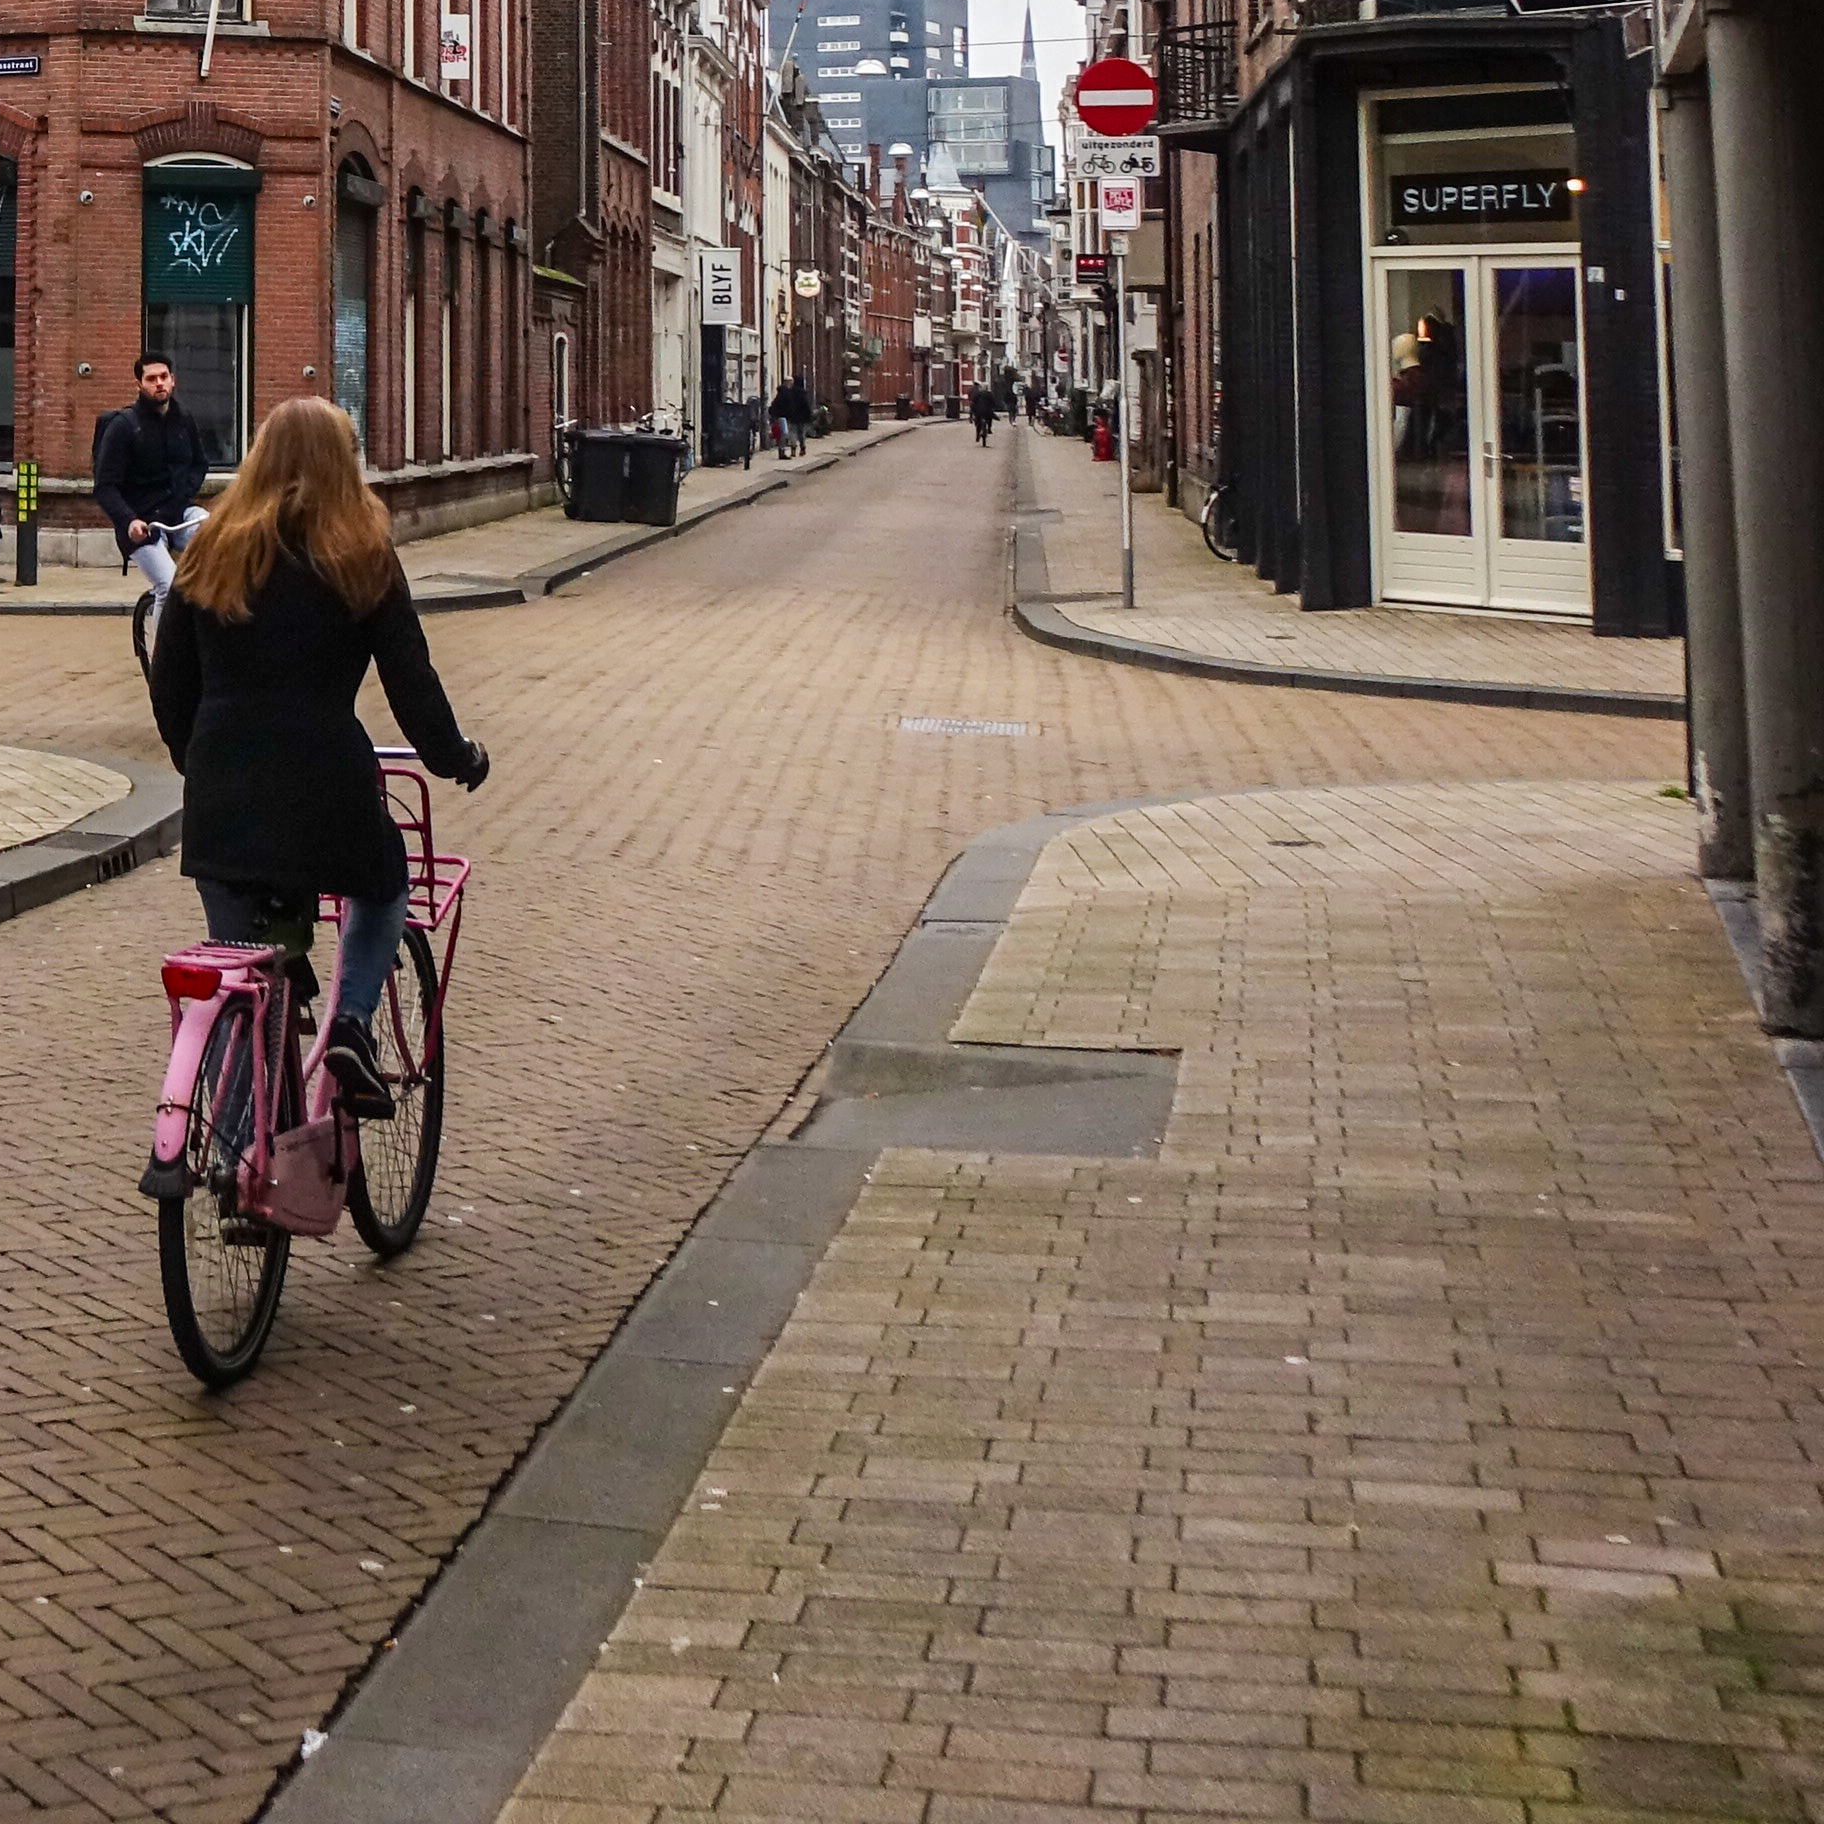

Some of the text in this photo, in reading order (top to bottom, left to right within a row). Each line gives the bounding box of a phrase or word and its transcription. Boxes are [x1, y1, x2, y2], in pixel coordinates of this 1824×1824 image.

[1081, 140, 1154, 151] uitgezonderd
[1403, 181, 1557, 214] SUPERFLY
[711, 263, 732, 305] BLYF
